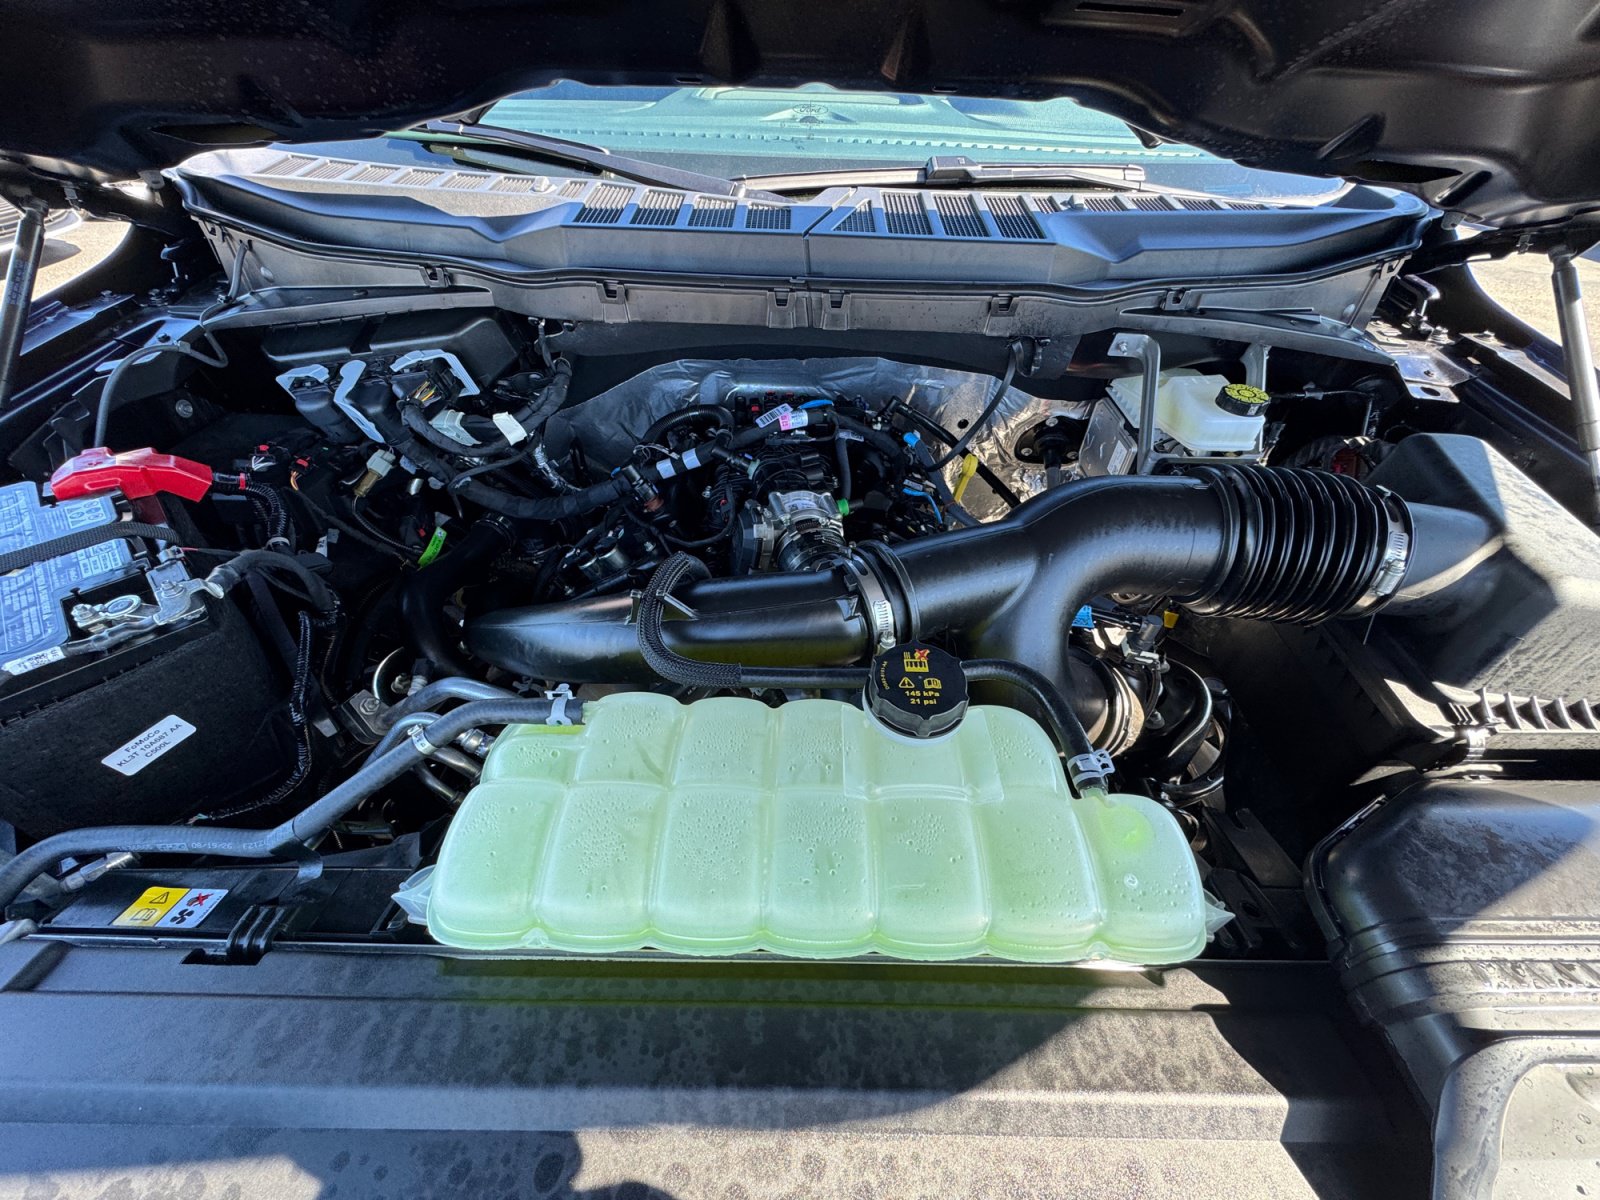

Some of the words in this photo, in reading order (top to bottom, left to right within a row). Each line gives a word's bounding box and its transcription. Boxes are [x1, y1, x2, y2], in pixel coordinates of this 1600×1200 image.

[923, 698, 937, 706] psi
[116, 751, 140, 767] KL3T
[170, 723, 182, 732] AA
[124, 729, 160, 752] FoMoCo
